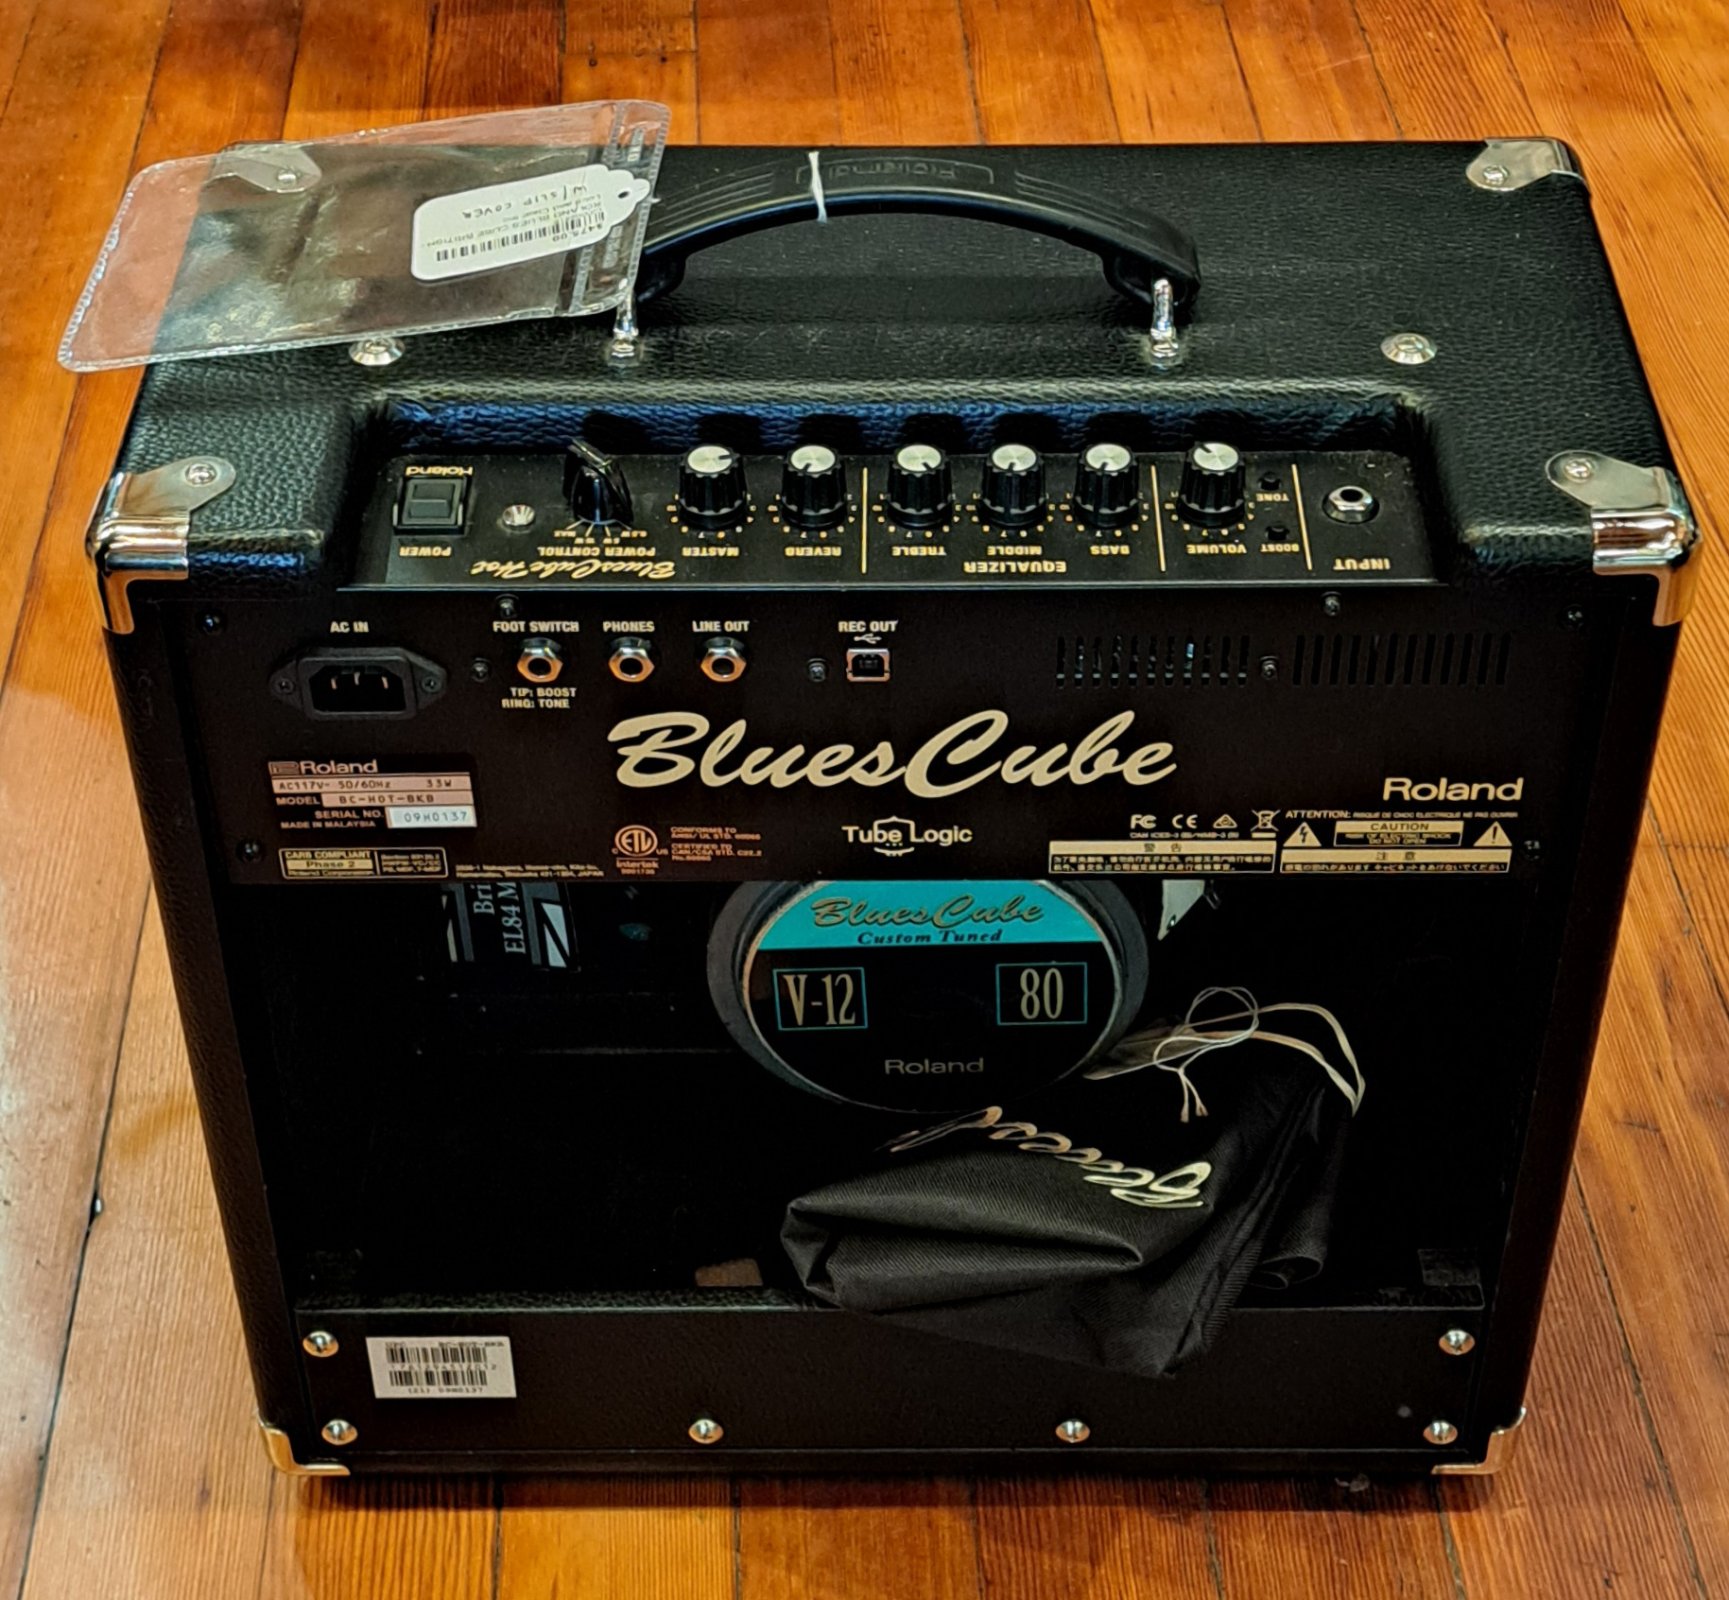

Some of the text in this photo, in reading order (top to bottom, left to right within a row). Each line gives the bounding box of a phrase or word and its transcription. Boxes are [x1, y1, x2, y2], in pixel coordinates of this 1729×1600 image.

[462, 201, 512, 220] COVER
[405, 466, 474, 477] Roland
[399, 546, 452, 557] POWER
[537, 546, 656, 557] POWER CONTROL
[682, 546, 740, 557] MASTER
[785, 546, 842, 557] REVERB
[892, 545, 947, 556] TREBLE
[987, 545, 1042, 556] MIDDLE
[1090, 545, 1130, 556] BASS
[1186, 543, 1247, 554] VOLUME
[1260, 543, 1300, 553] BOOST
[470, 560, 529, 579] Hot
[963, 561, 1067, 573] EQUALIZER
[1333, 558, 1391, 570] INPUT
[330, 621, 369, 633] AC IN
[493, 621, 580, 633] FOOT SWITCH
[603, 621, 655, 632] PHONES
[692, 620, 750, 633] LINE OUT
[838, 620, 898, 633] REC OUT
[536, 687, 577, 697] BOOST
[501, 699, 570, 709] RING: TONE
[300, 759, 379, 774] Roland
[337, 779, 392, 790] 50/60Hz
[426, 778, 452, 788] 33W
[1382, 777, 1524, 801] Roland
[275, 796, 320, 806] MODEL
[314, 810, 360, 820] SERIAL
[362, 809, 385, 819] NO.
[1285, 809, 1351, 819] ATTENTION:
[280, 820, 376, 829] MADE IN MALAYSIA
[1370, 822, 1429, 831] CAUTION
[841, 822, 973, 847] Tube Logic
[313, 850, 371, 859] COMPLIANT
[500, 904, 527, 955] EL84
[857, 929, 1002, 946] Custom Tuned
[1019, 967, 1065, 1020] 80
[782, 973, 856, 1026] V-12
[884, 1057, 985, 1075] Roland
